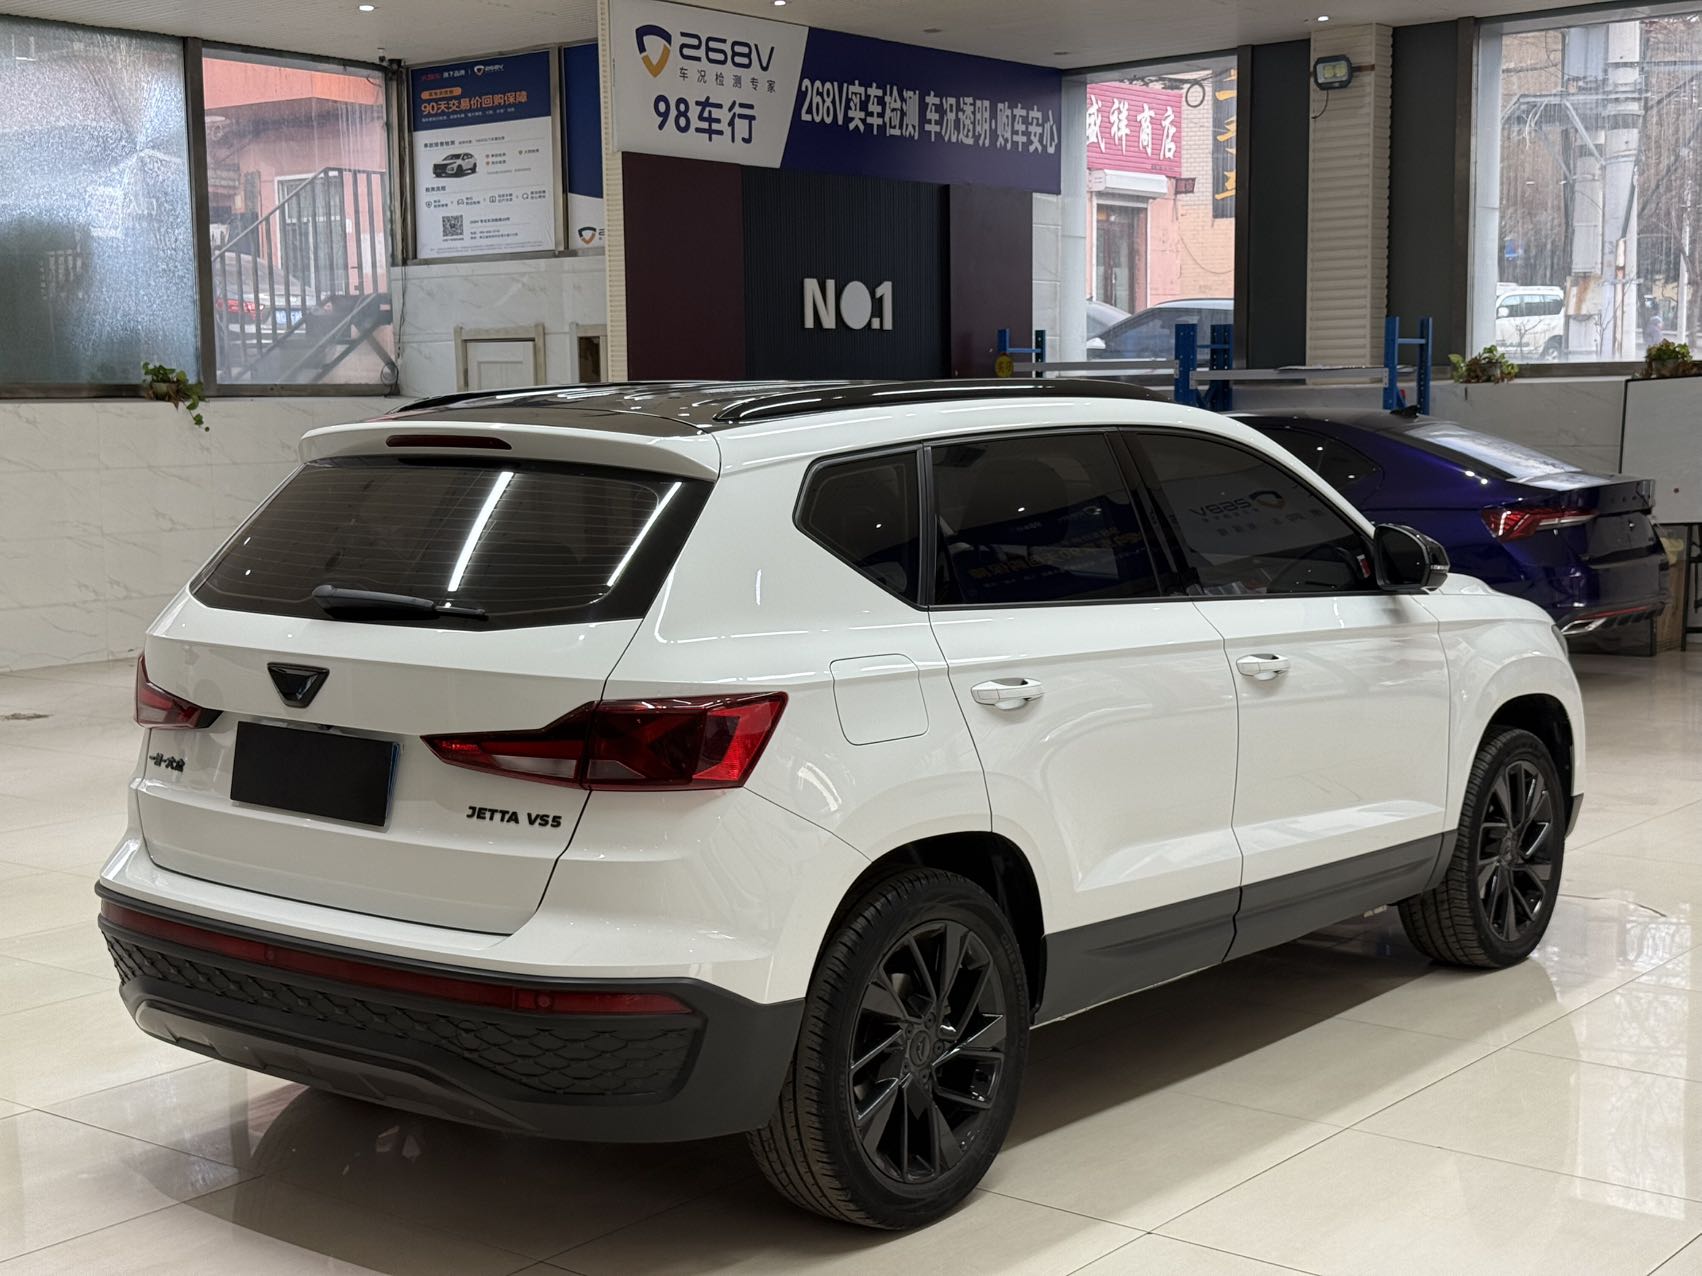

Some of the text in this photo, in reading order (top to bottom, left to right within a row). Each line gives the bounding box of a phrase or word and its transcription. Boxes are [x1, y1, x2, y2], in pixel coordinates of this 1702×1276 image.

[679, 31, 775, 72] 268V
[679, 67, 776, 94] 车况检测专家
[421, 91, 529, 116] 90天交易价回购保障
[653, 94, 757, 145] 98车行
[801, 78, 919, 141] 268V实车检测
[803, 278, 893, 330] NO.1
[466, 806, 563, 828] JETTA VS5
